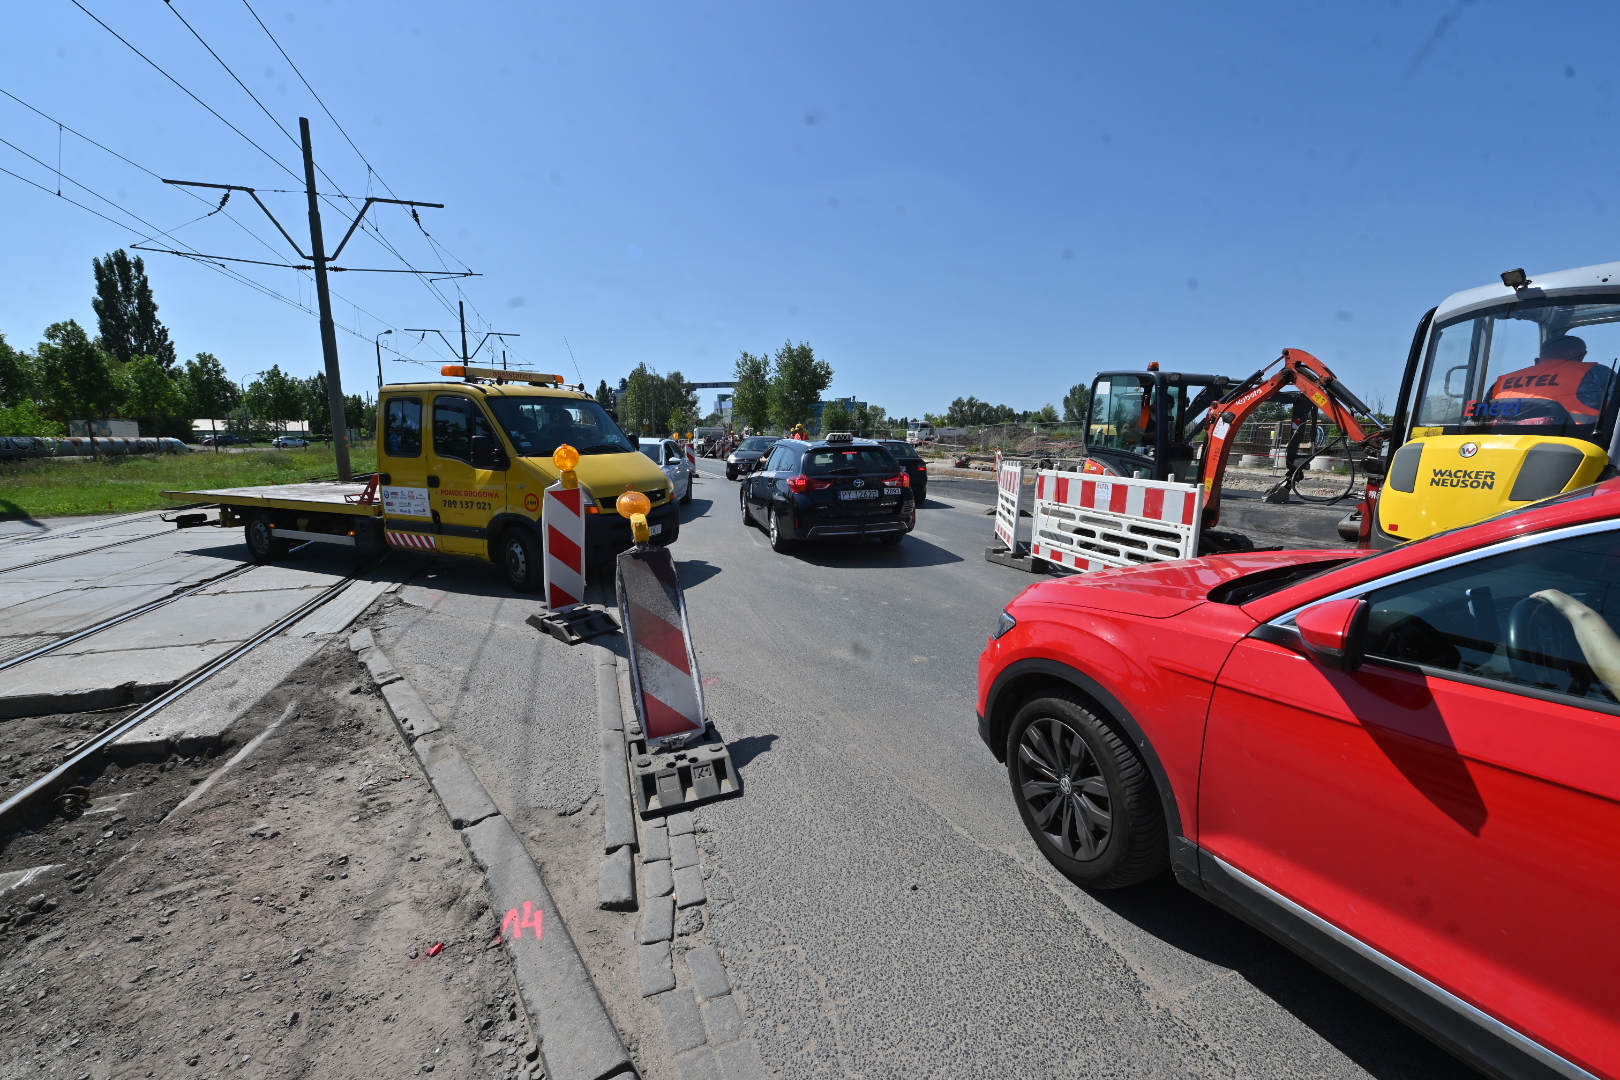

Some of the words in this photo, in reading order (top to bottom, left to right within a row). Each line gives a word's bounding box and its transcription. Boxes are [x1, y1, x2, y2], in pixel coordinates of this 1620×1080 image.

[492, 371, 533, 380] assistance
[1502, 373, 1560, 390] ELTEL
[1464, 398, 1523, 417] Eneel
[1432, 468, 1496, 481] WACKER
[1097, 482, 1110, 490] ELTEL
[1429, 477, 1495, 491] NEUSON
[440, 489, 463, 497] POMOC
[464, 490, 500, 499] DROGOWA
[442, 499, 457, 509] 789
[460, 500, 475, 510] 137
[476, 501, 492, 511] 021
[501, 900, 544, 940] 14
